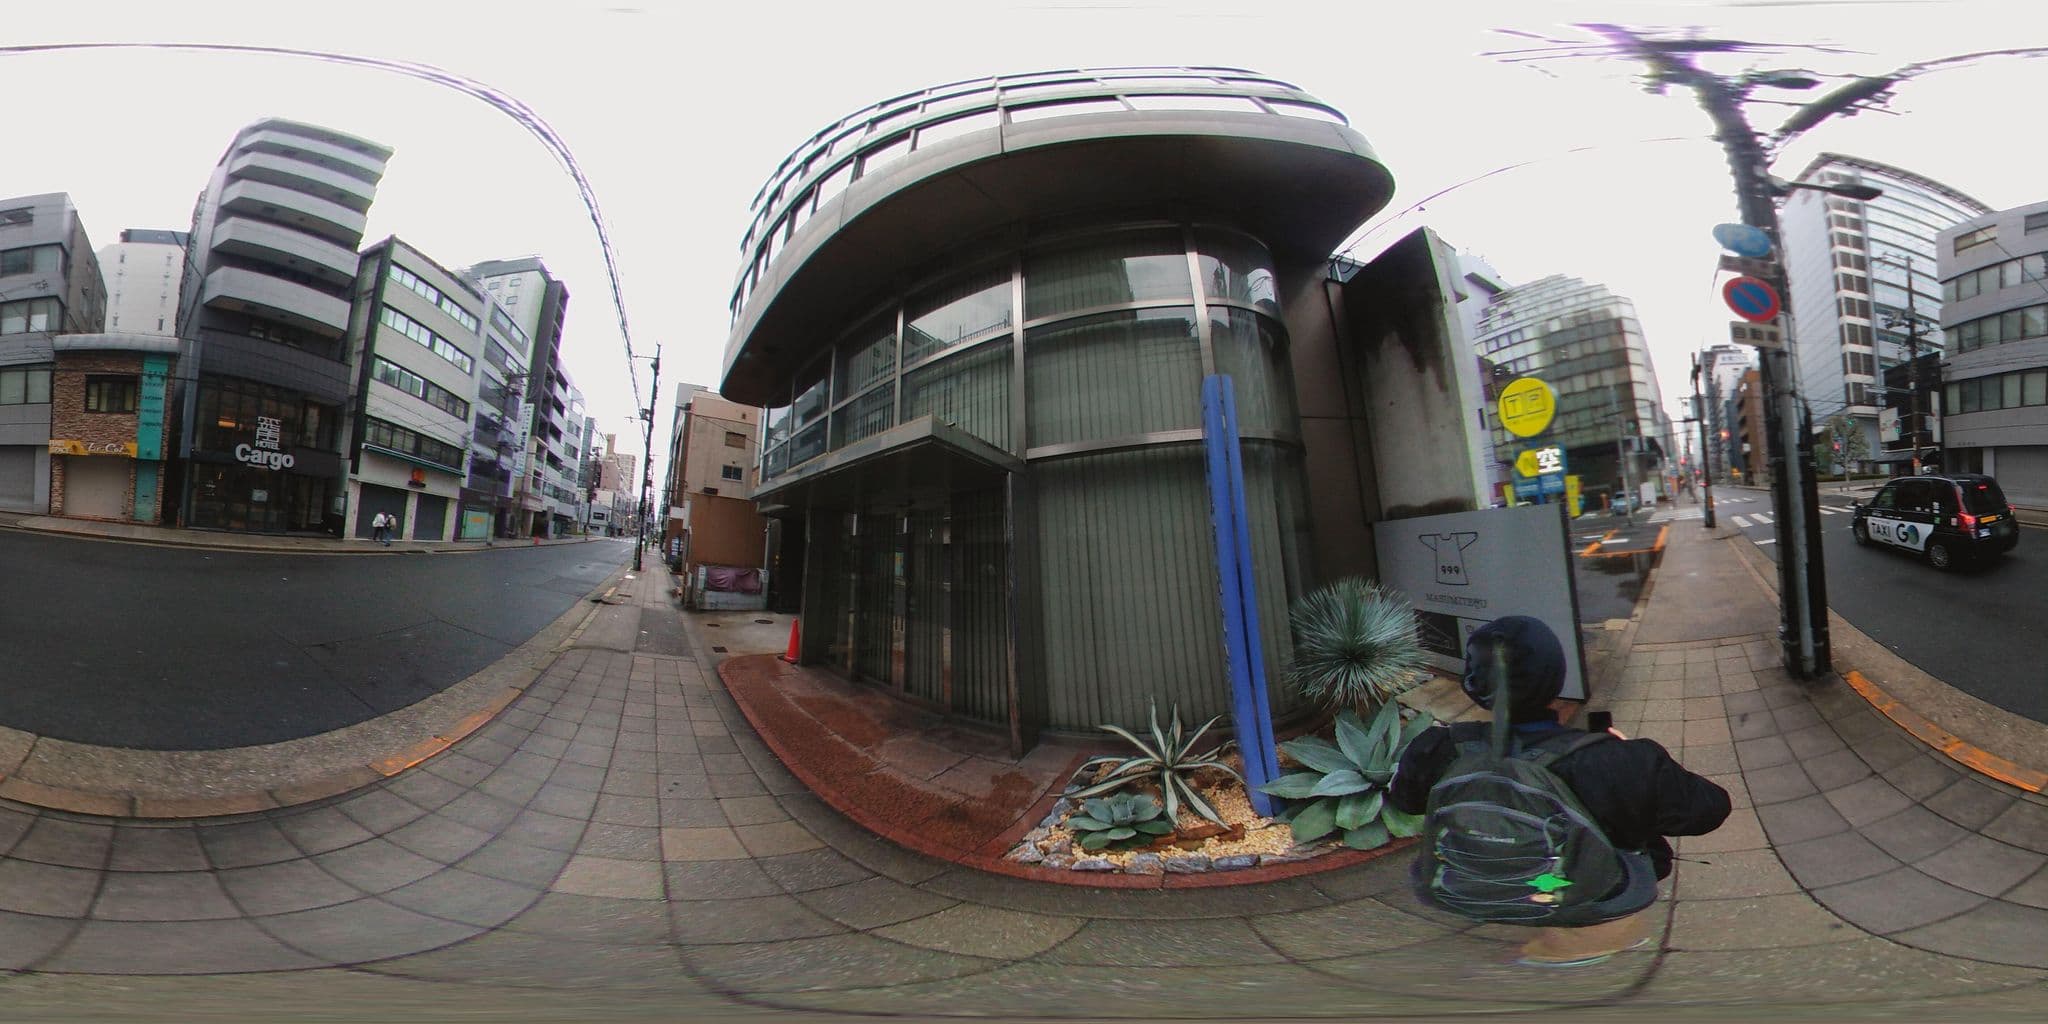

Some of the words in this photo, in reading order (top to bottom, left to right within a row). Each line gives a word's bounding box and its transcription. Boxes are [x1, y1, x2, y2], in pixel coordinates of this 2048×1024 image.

[235, 443, 295, 470] Cargo
[1536, 447, 1564, 473] 空
[1871, 522, 1892, 537] TAXI
[1896, 523, 1920, 546] GO
